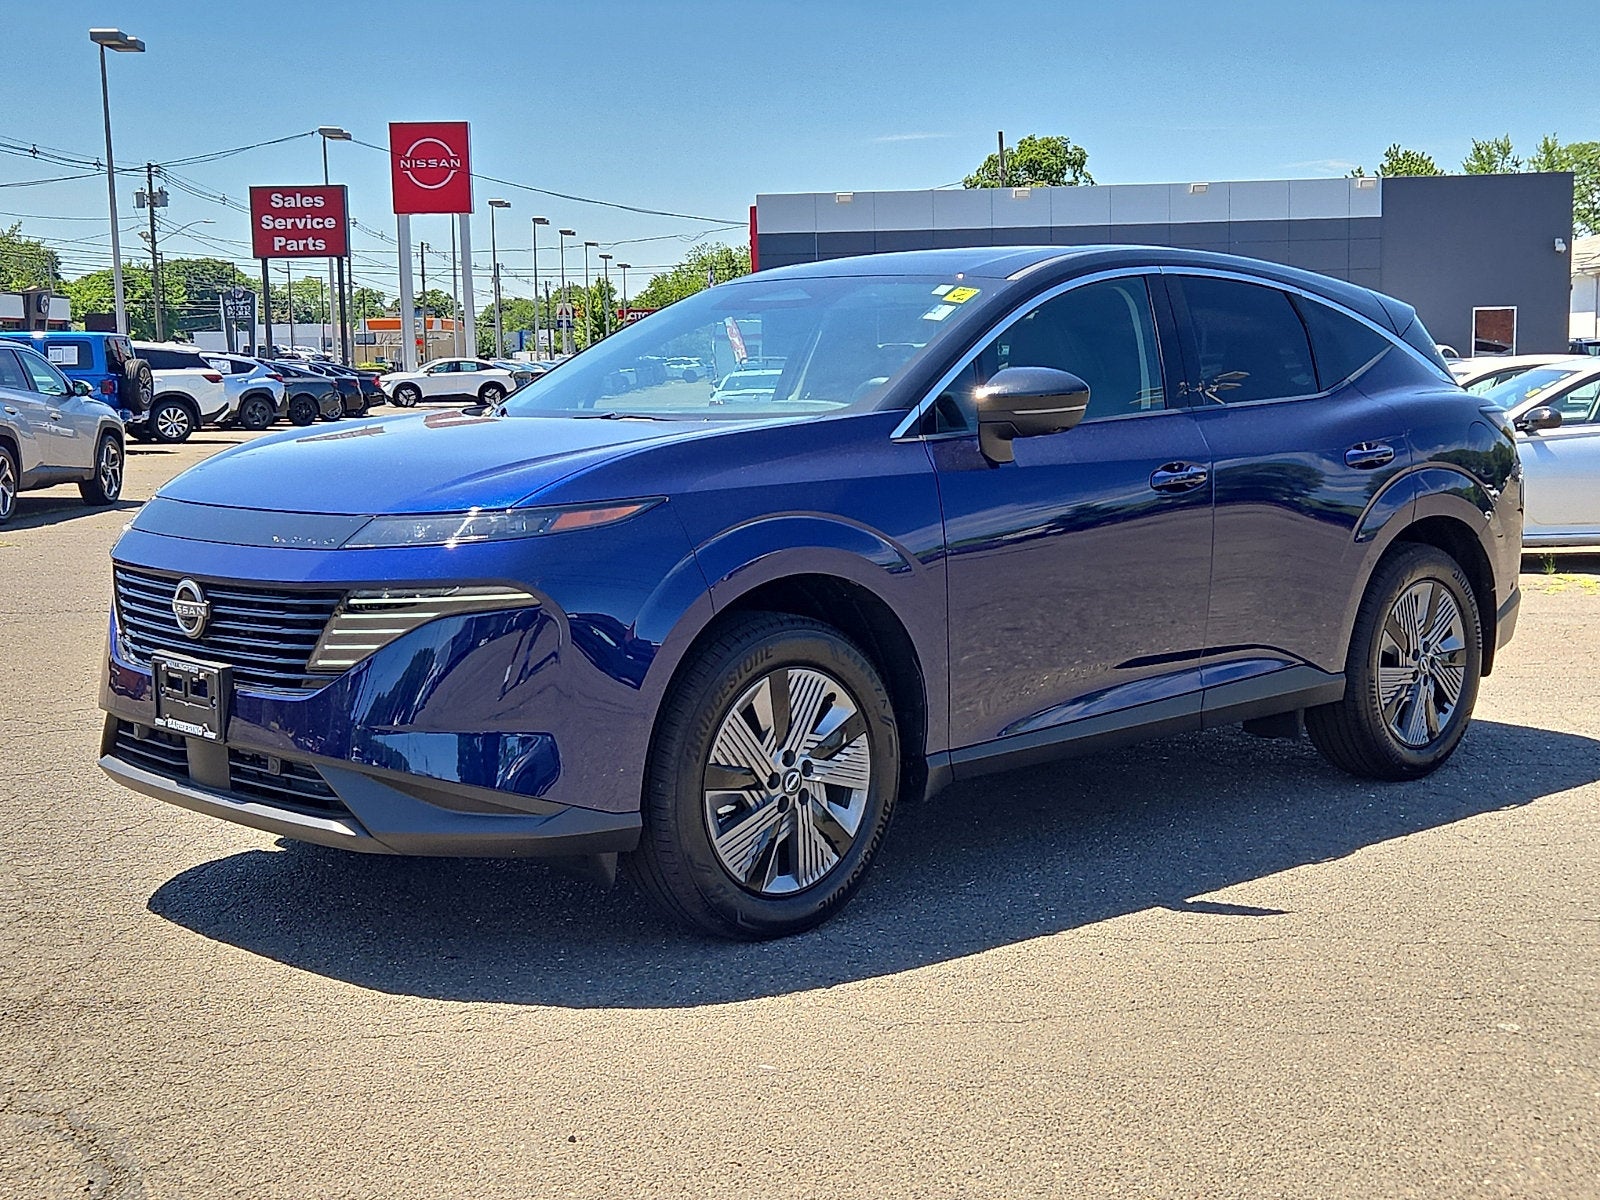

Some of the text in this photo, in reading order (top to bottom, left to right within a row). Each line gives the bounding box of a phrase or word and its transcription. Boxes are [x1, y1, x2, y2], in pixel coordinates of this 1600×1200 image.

[400, 158, 460, 169] NISSAN
[270, 192, 325, 208] Sales
[261, 214, 337, 230] Service
[273, 236, 327, 252] Parts
